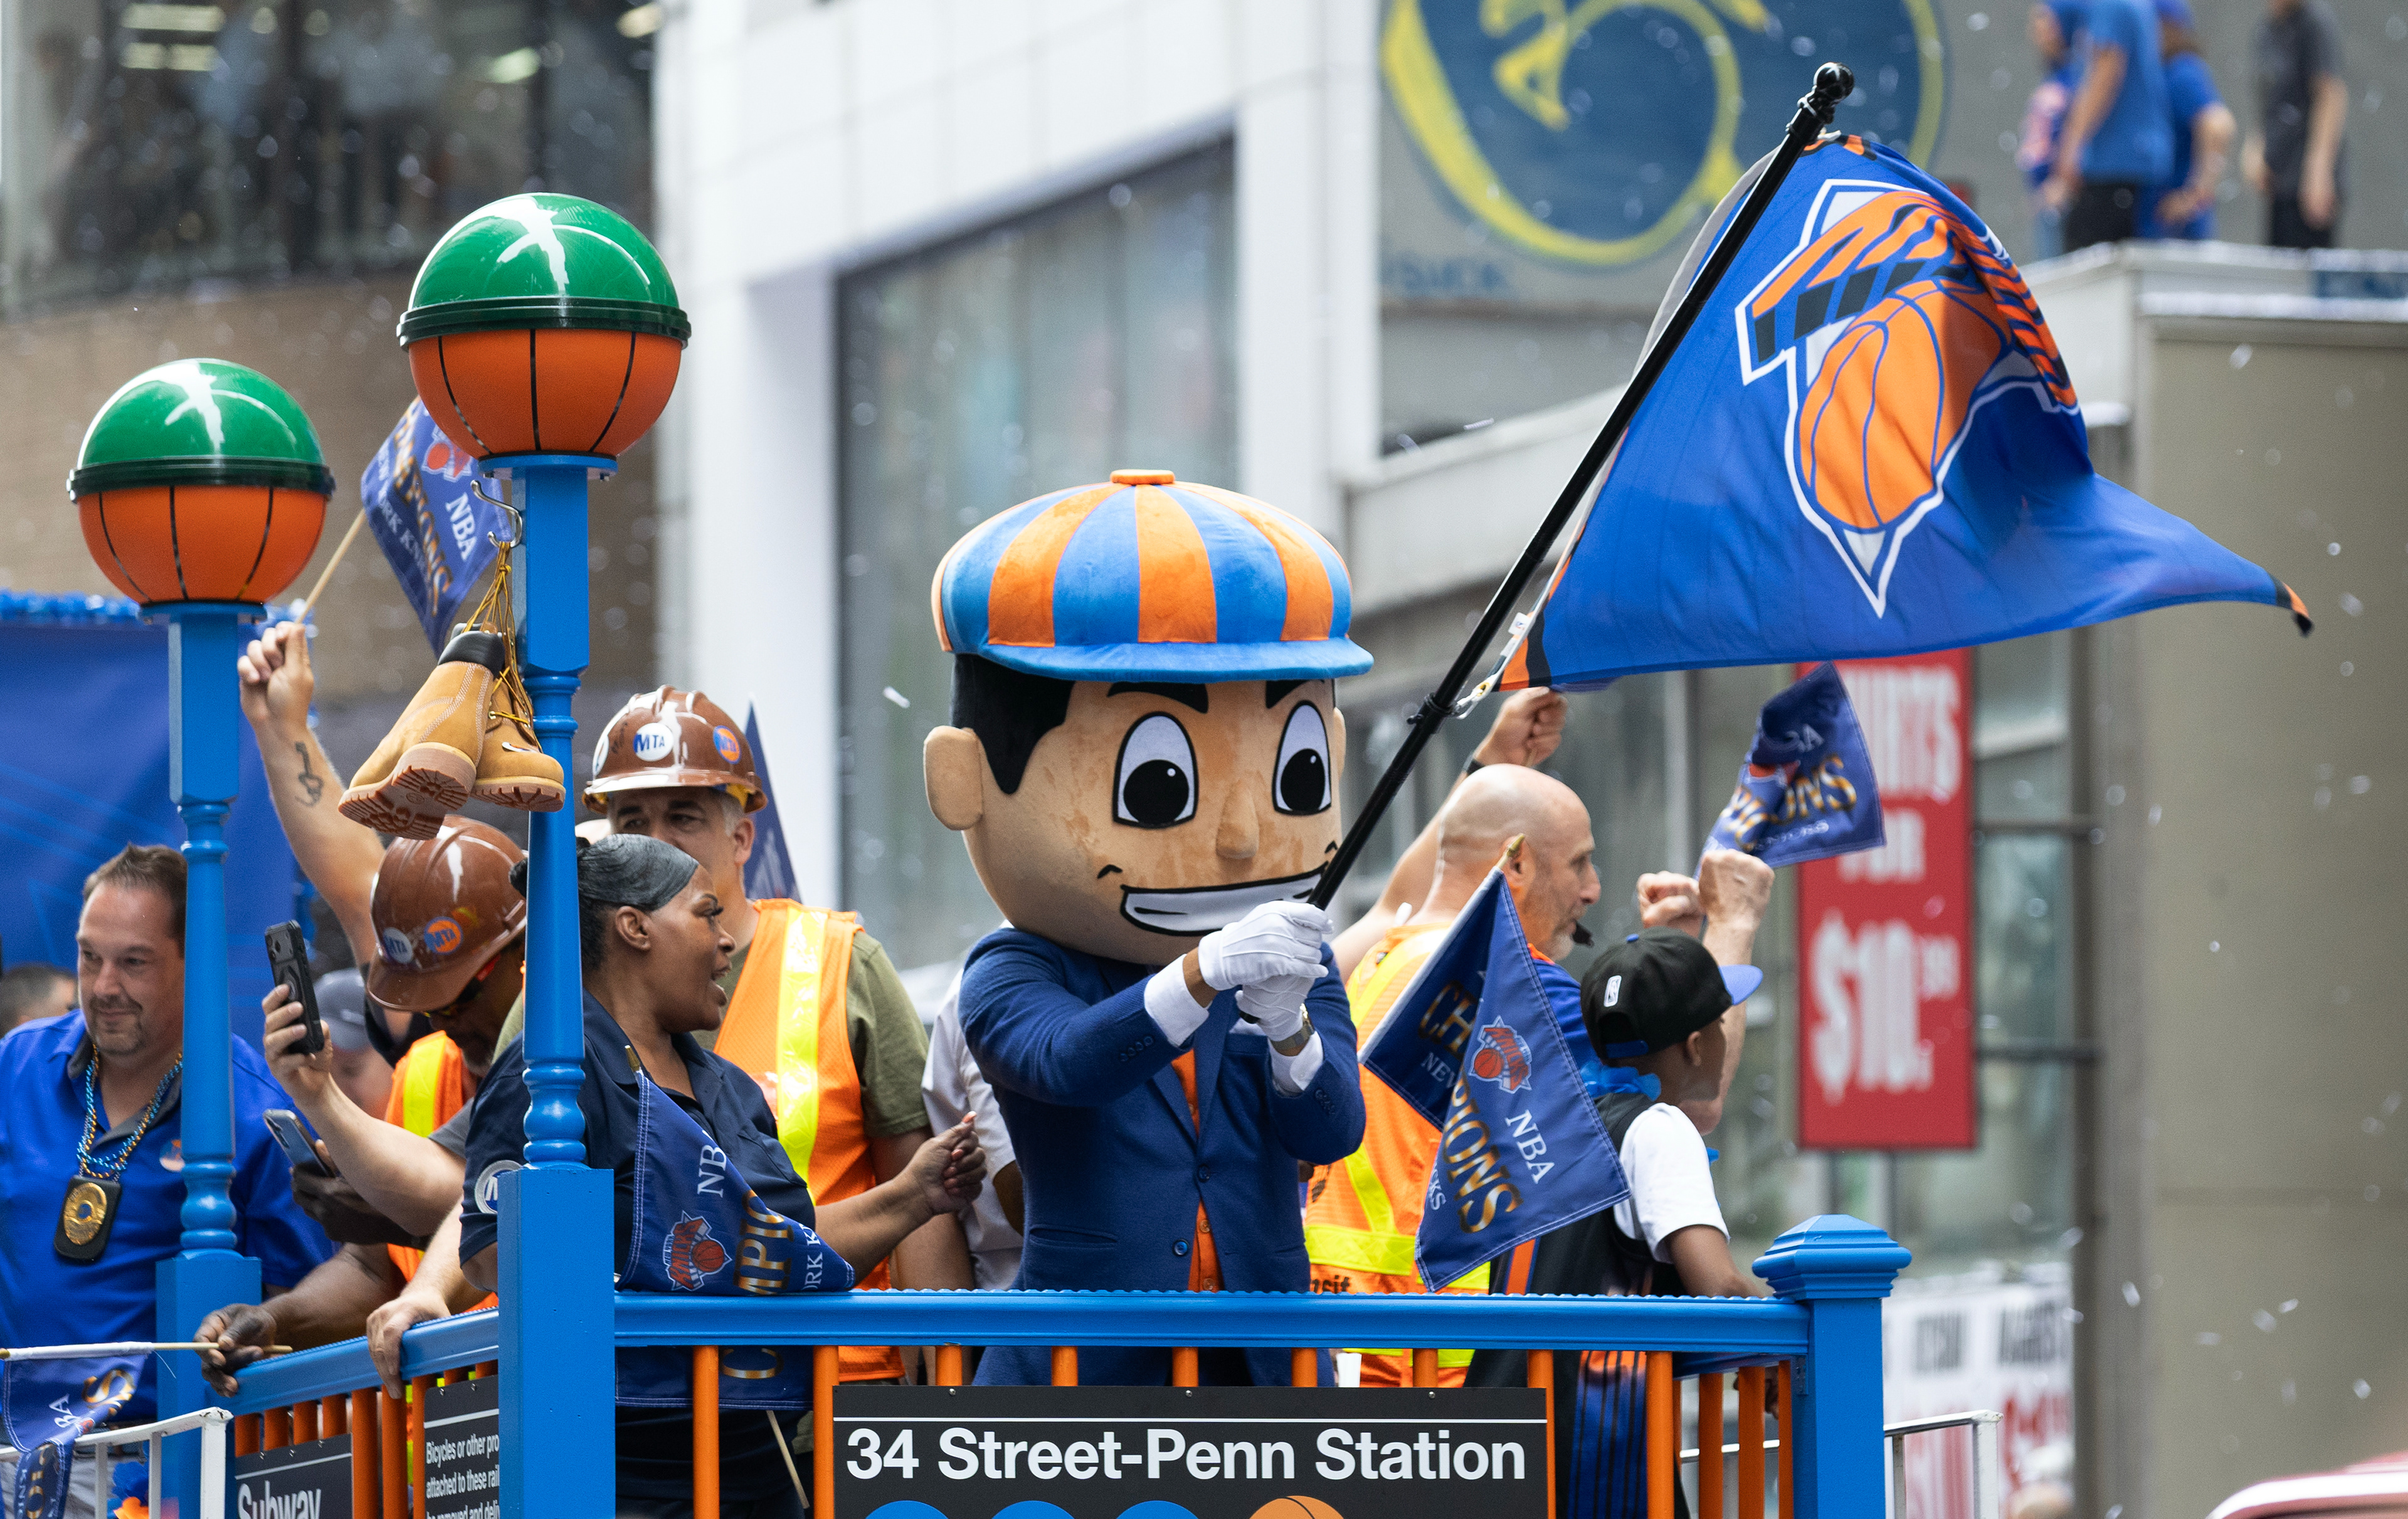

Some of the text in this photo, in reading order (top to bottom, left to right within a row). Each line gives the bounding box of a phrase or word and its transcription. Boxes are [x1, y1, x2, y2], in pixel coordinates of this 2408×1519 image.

[445, 492, 477, 561] NBA
[635, 732, 666, 753] MTA
[428, 928, 457, 948] MTA
[1505, 1109, 1556, 1185] NBA
[669, 1219, 703, 1289] KNICKS
[426, 1433, 500, 1468] Bicycles or other pro
[847, 1427, 1525, 1480] 34 Street-Penn Station
[238, 1479, 322, 1519] Subway
[426, 1464, 500, 1499] attached to these rail
